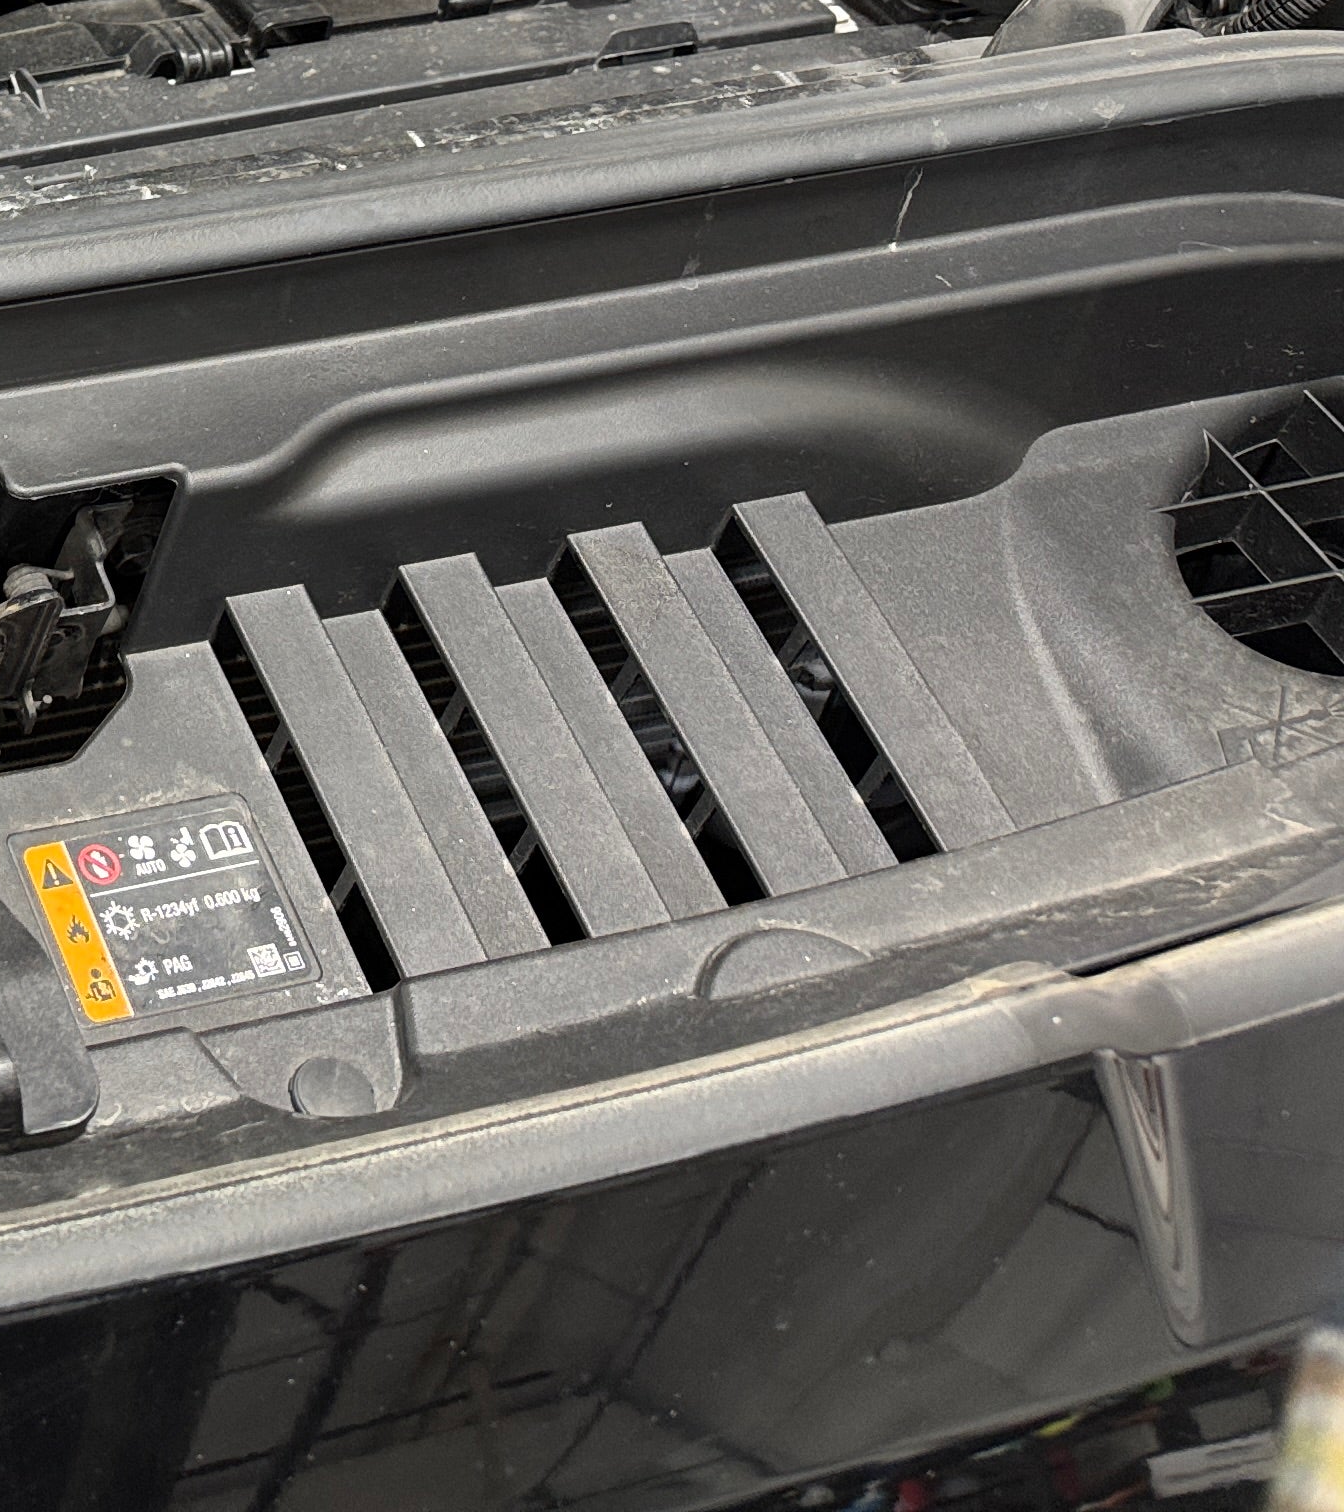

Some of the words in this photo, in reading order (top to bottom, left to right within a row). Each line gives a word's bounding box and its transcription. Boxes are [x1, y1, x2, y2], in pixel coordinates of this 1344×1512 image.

[136, 859, 167, 876] AUTO
[140, 897, 200, 922] R-1234yf
[241, 887, 261, 902] kg
[162, 954, 193, 975] PAG
